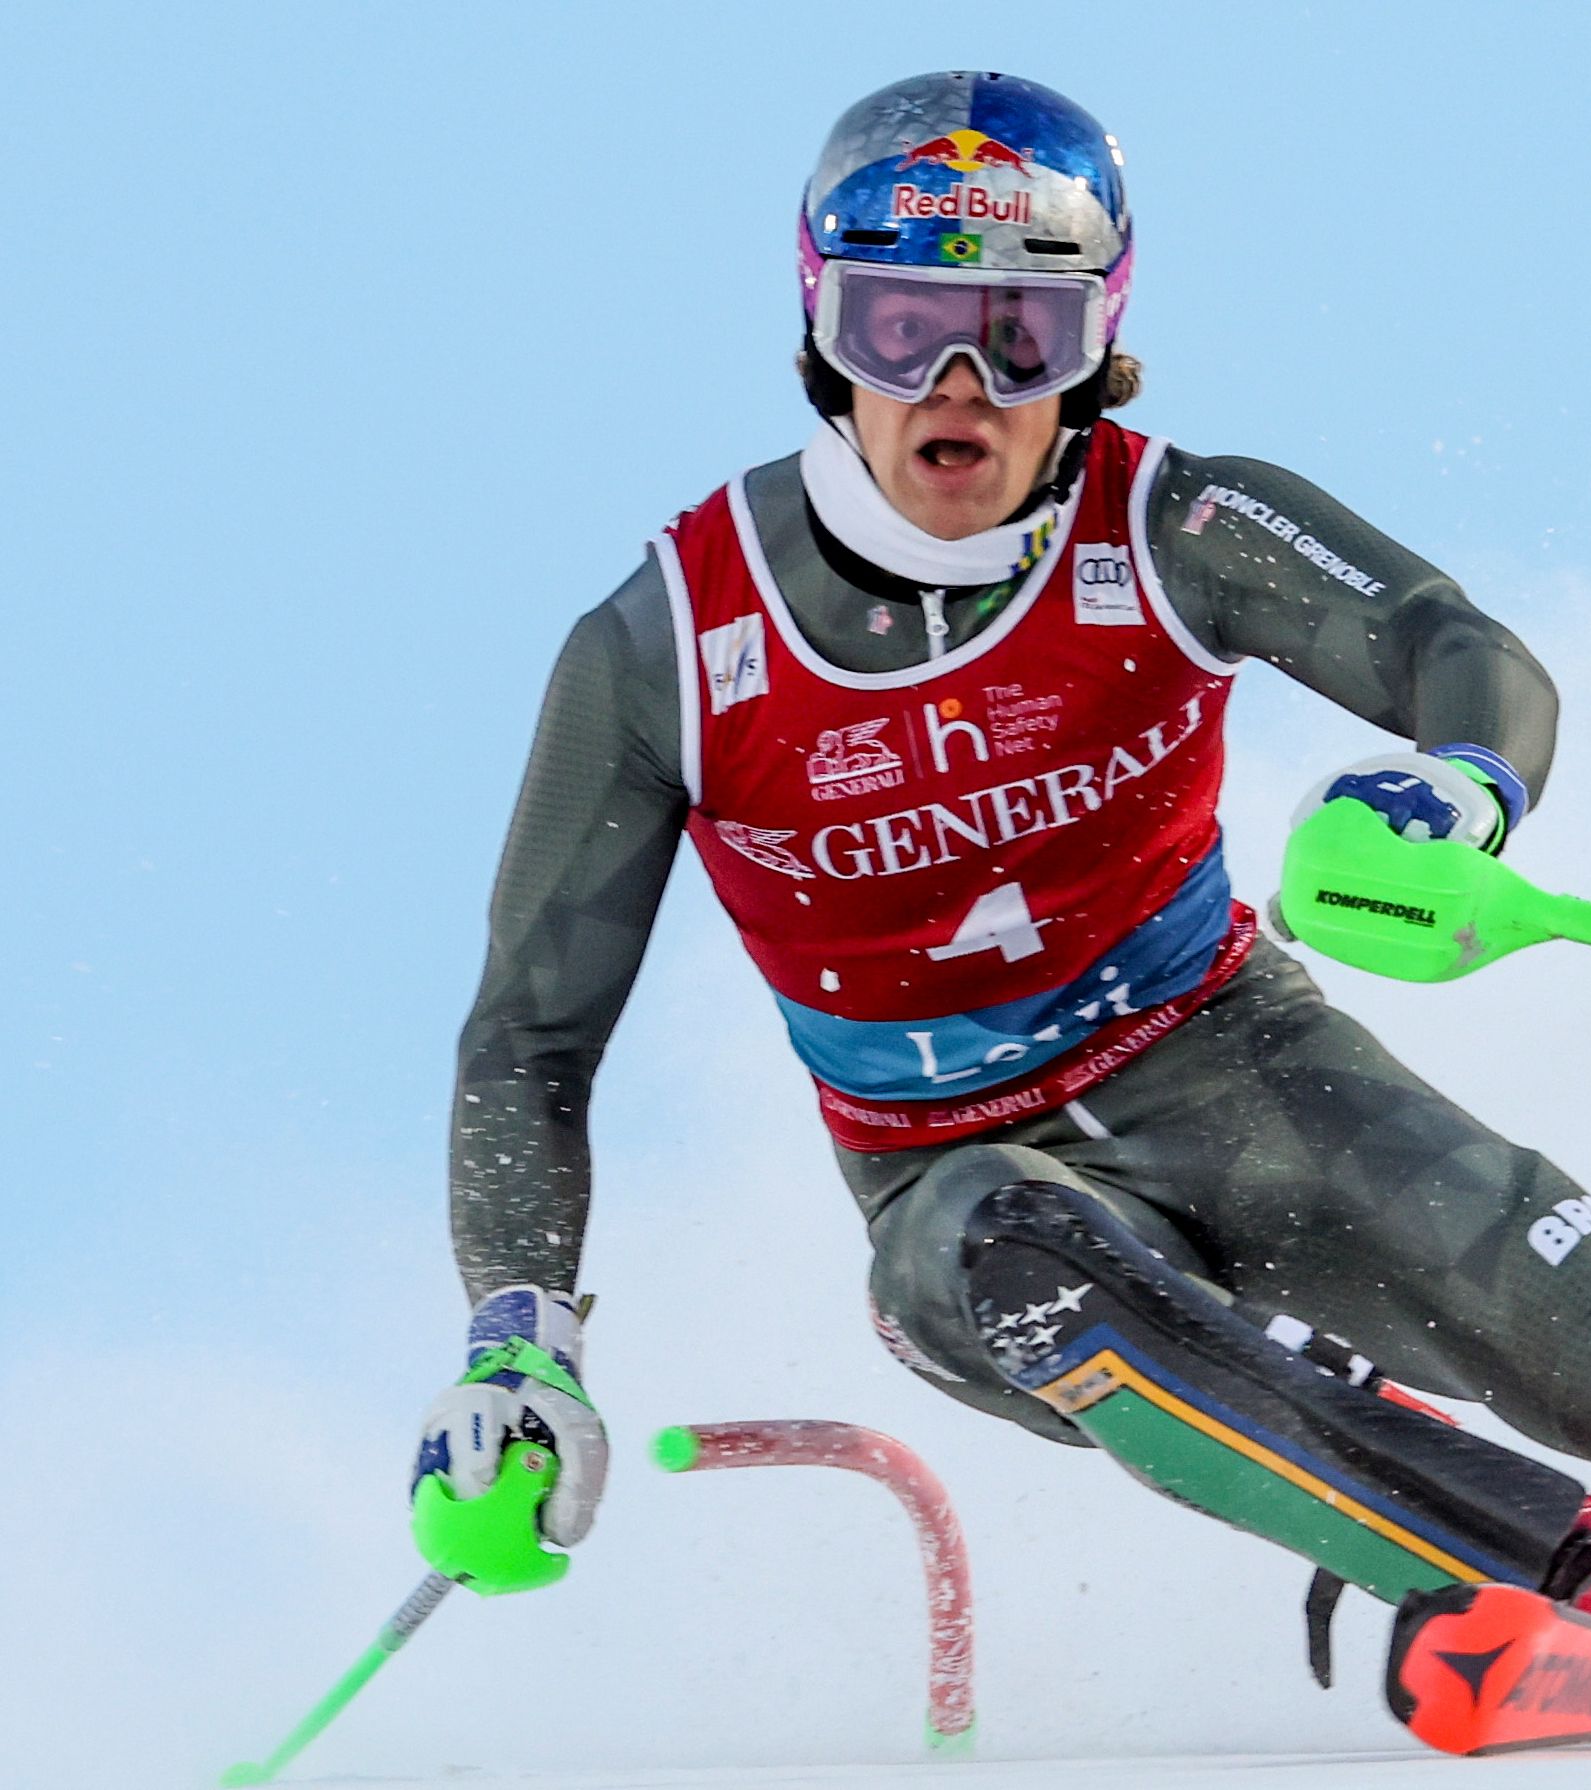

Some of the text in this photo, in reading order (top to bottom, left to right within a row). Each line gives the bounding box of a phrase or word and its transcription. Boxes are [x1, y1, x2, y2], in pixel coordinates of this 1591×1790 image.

[893, 184, 1031, 224] Red Bull
[1197, 484, 1386, 598] MONCLER GRENOBLE
[982, 684, 1024, 702] The
[811, 768, 904, 801] GENERALI
[812, 692, 1206, 880] GENERALI
[926, 882, 1052, 962] 4
[1315, 889, 1436, 925] KOMPERDELL
